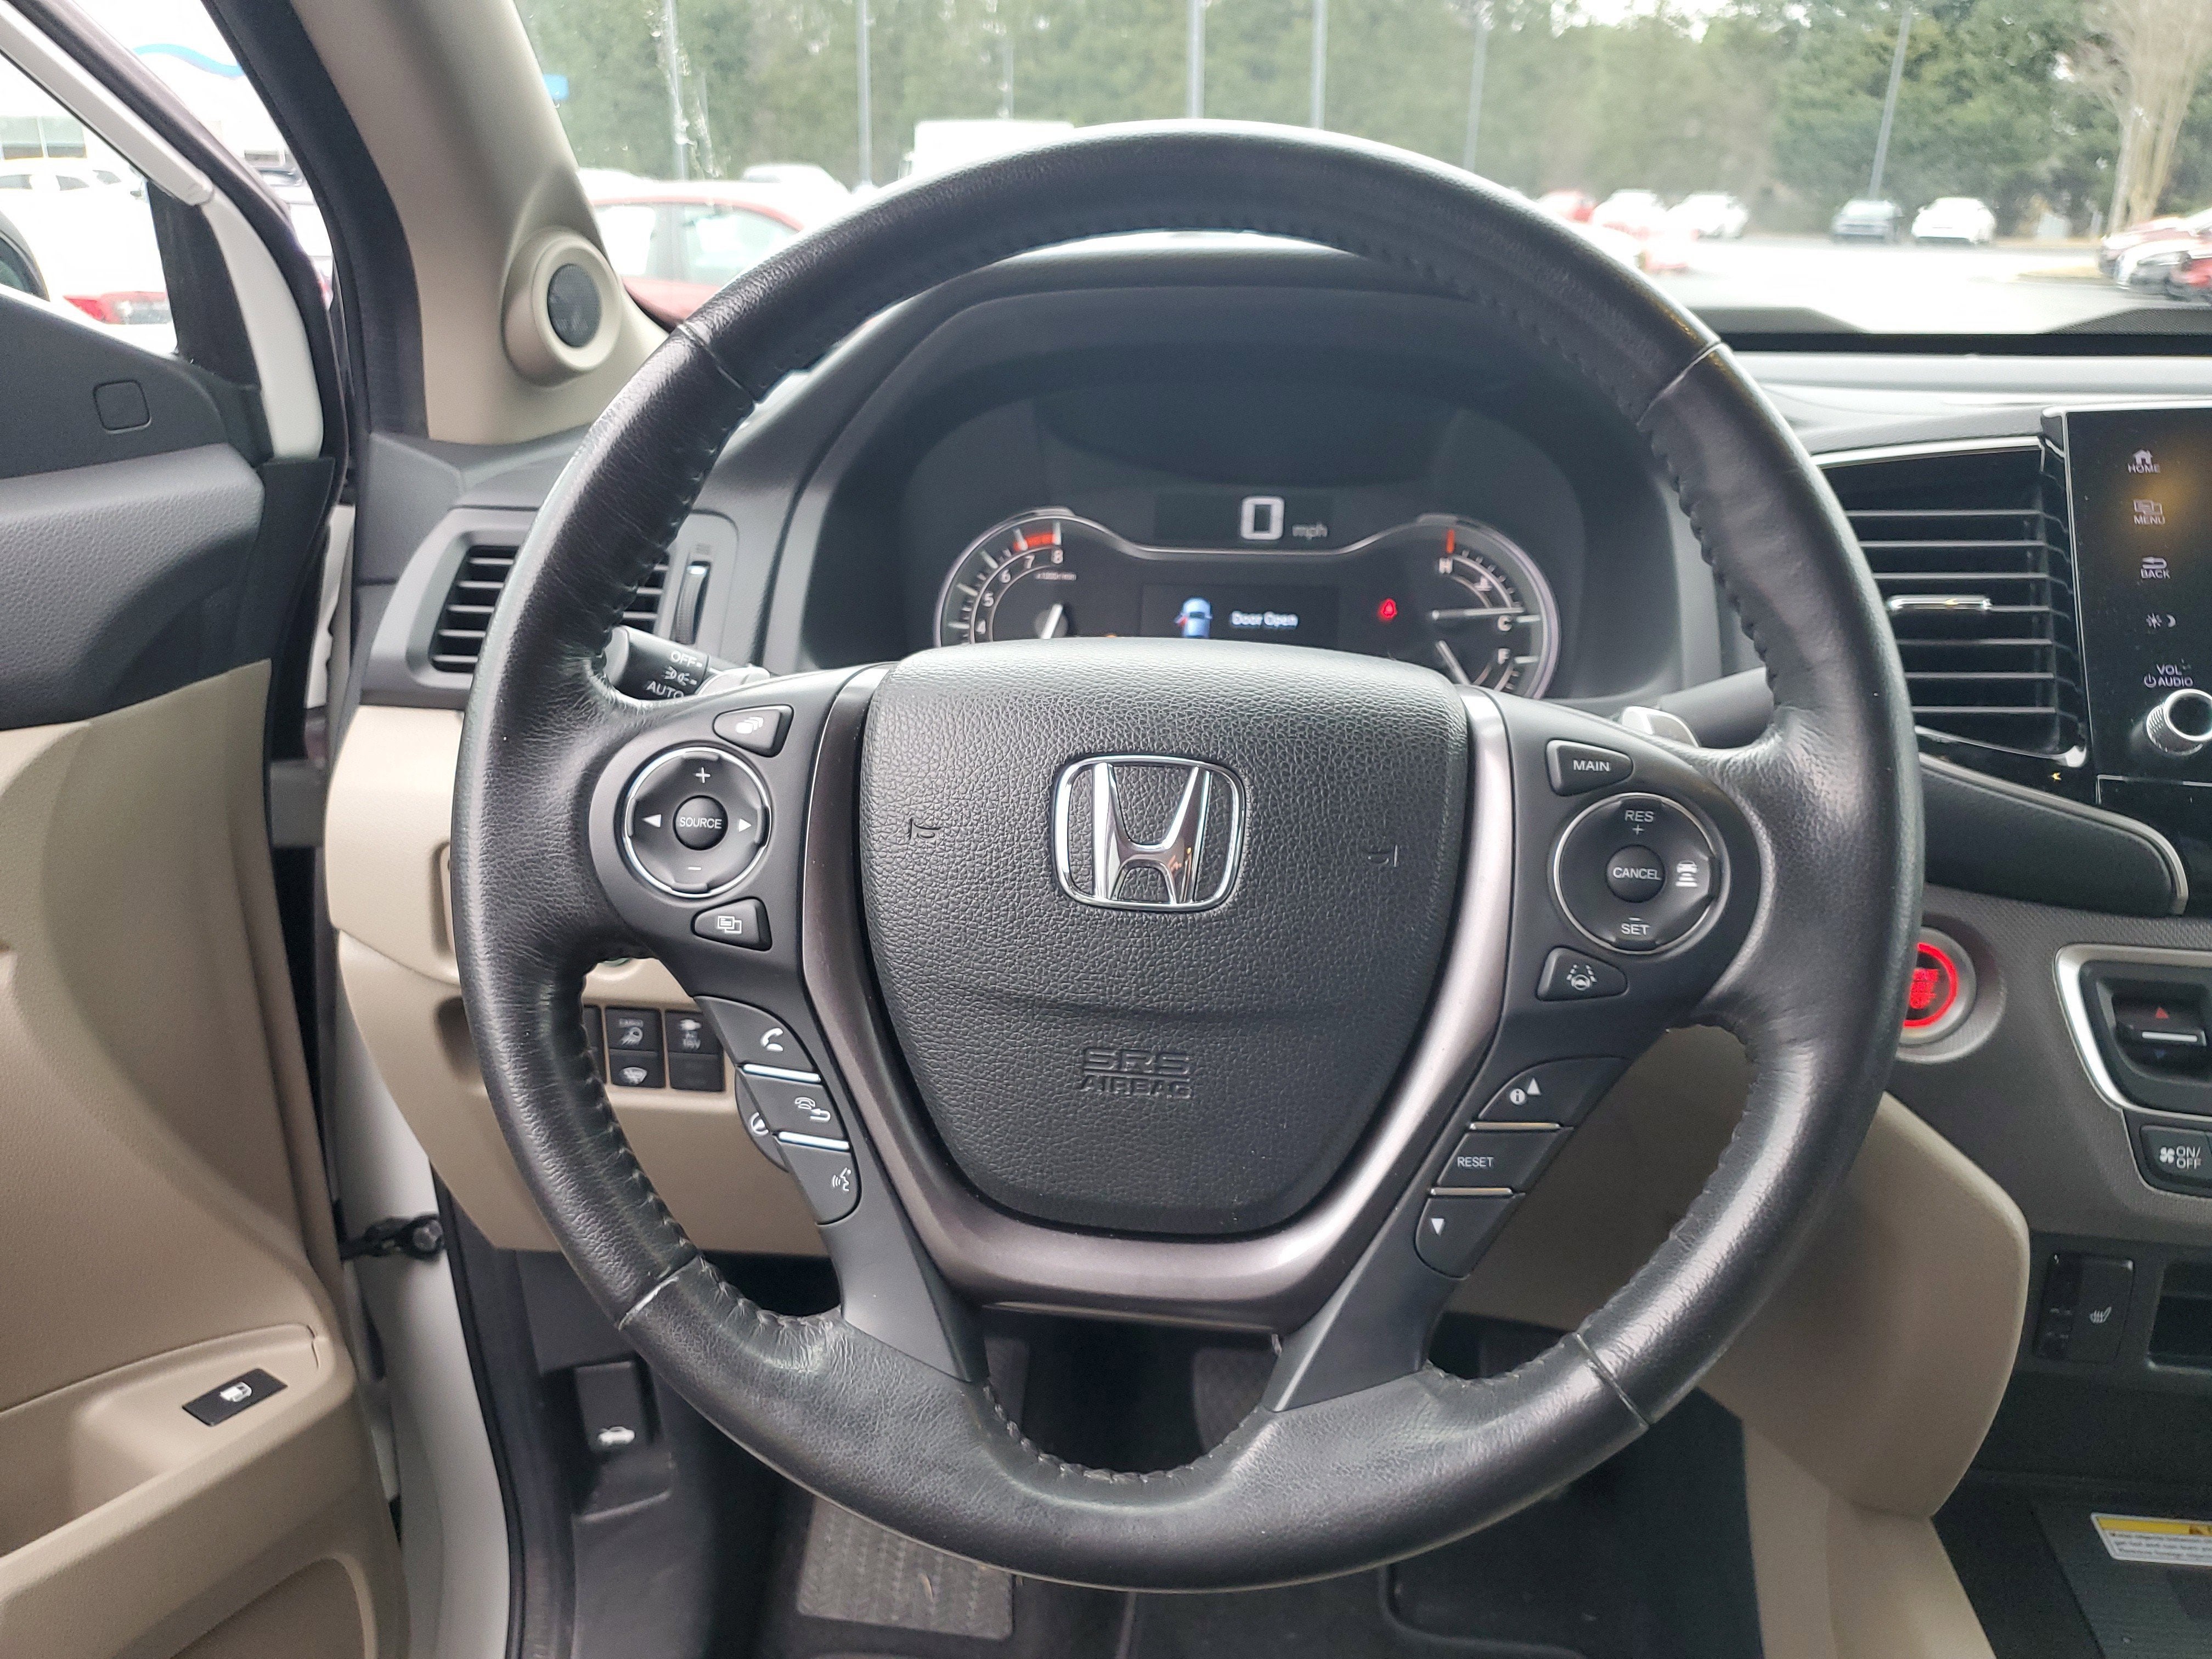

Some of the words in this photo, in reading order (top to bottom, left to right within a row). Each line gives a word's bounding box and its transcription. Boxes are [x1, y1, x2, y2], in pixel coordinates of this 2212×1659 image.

[2127, 463, 2160, 473] HOME
[1240, 495, 1285, 540] 0
[1292, 522, 1328, 540] mph
[2133, 514, 2166, 525] MENU
[1024, 554, 1035, 569] 7
[1051, 549, 1064, 565] 8
[1438, 557, 1453, 574] H
[998, 568, 1011, 584] 6
[2140, 568, 2171, 580] BACK
[983, 591, 994, 607] 5
[975, 618, 986, 634] 4
[1231, 610, 1263, 627] Door
[1263, 611, 1299, 628] Open
[1497, 614, 1512, 631] C
[670, 650, 698, 667] OFF
[1497, 647, 1511, 665] F
[2156, 664, 2182, 675] VOL
[2158, 676, 2193, 687] AUDIO
[646, 680, 684, 699] AUTO
[1573, 759, 1610, 772] MAIN
[680, 816, 723, 830] SOURCE
[1624, 809, 1654, 823] RES
[1612, 866, 1661, 881] CANCEL
[1621, 923, 1650, 935] SET
[1084, 1048, 1190, 1075] SRS
[1079, 1074, 1193, 1099] AIRBAG
[2176, 1146, 2201, 1158] ON/
[1457, 1156, 1494, 1168] RESET
[2176, 1157, 2202, 1170] OFF
